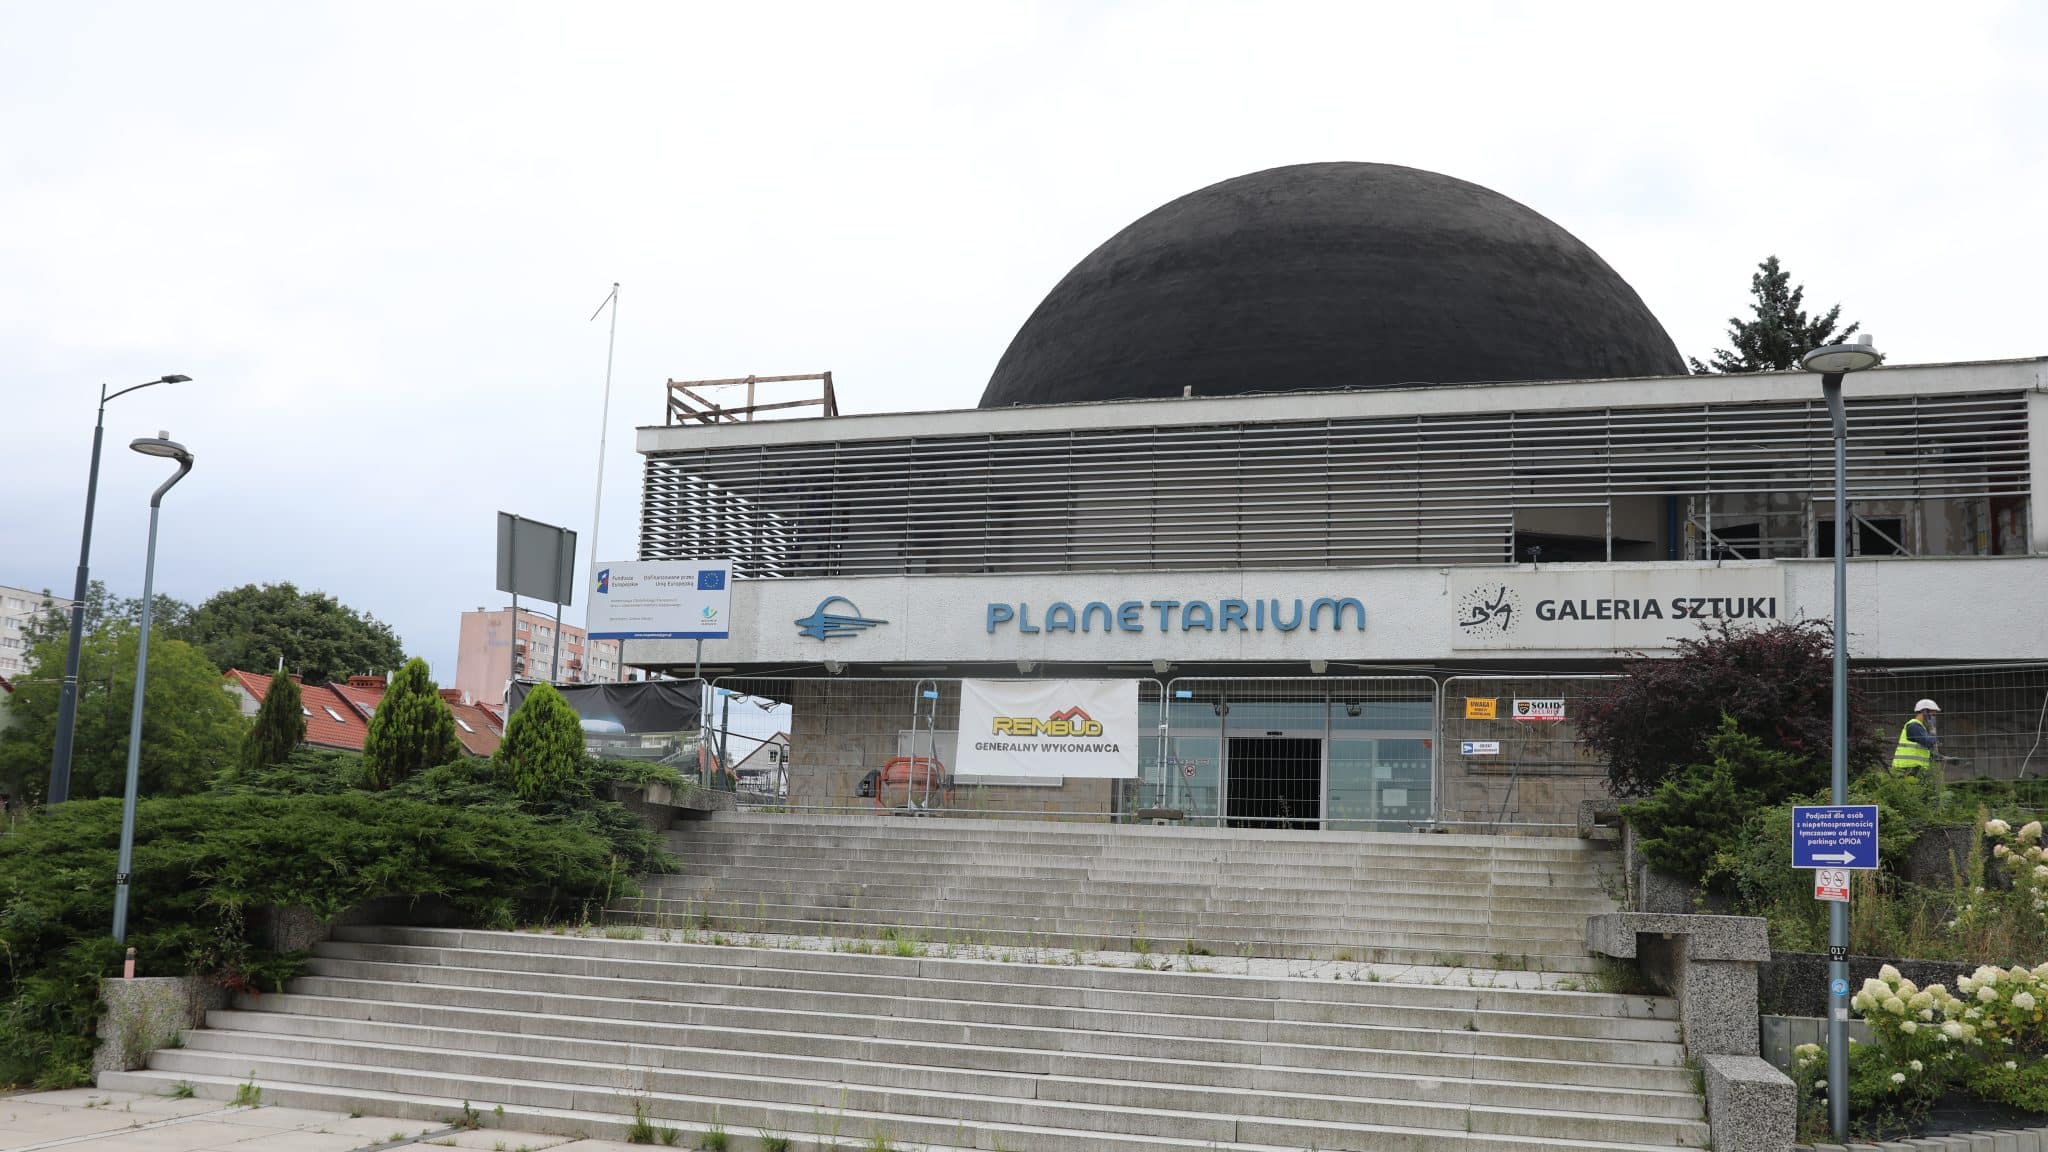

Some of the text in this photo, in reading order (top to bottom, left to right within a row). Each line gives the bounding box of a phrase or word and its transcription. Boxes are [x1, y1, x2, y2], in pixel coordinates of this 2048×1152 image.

[1459, 586, 1513, 631] BWA
[1535, 596, 1776, 621] GALERIA SZTUKI
[986, 597, 1366, 634] PLANETARIUM
[1531, 701, 1560, 709] SOLID
[992, 716, 1103, 737] REMBUD
[975, 742, 1120, 753] GENERALNY WYKONAWCA
[1805, 812, 1832, 820] Podjazd
[1846, 811, 1864, 819] osób
[1849, 830, 1871, 838] strony
[1807, 838, 1837, 846] parkingu
[1830, 946, 1847, 955] 017
